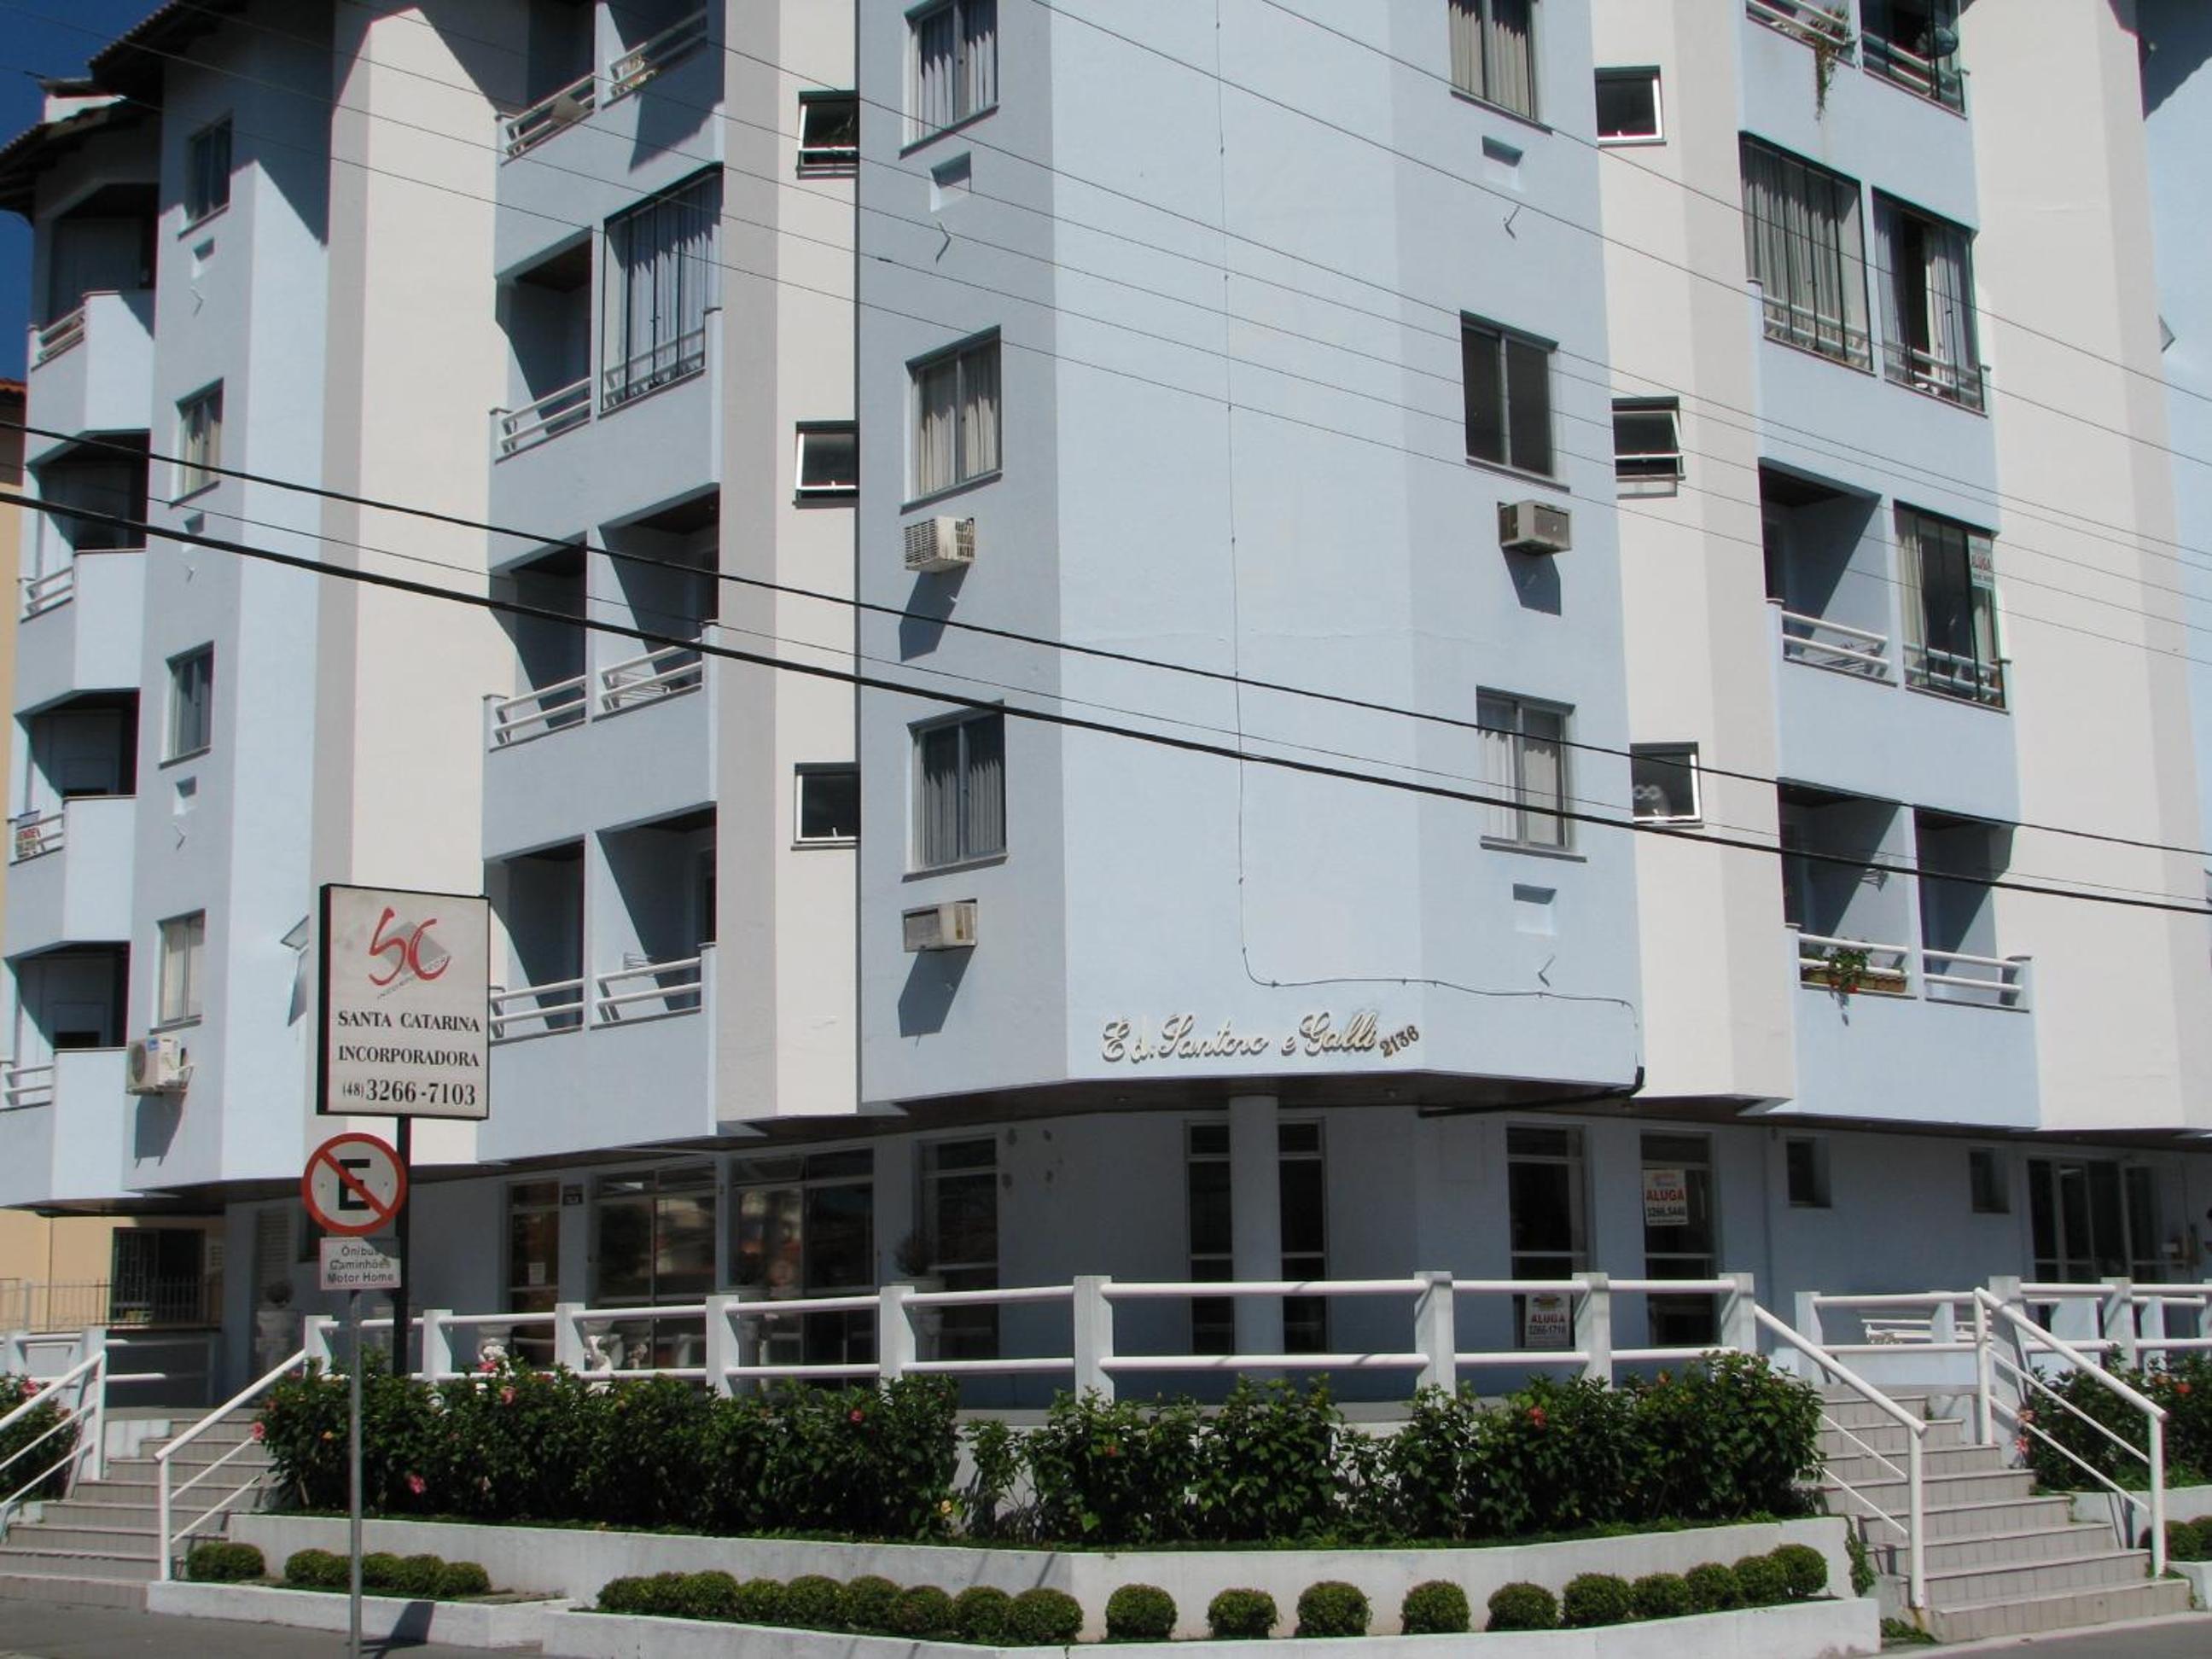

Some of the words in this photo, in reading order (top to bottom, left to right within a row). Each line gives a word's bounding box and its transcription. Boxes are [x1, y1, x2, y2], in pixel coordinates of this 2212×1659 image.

[338, 1010, 392, 1027] SANTA
[400, 1012, 480, 1033] CATARINA
[1160, 1014, 1271, 1059] Santoro
[1281, 1034, 1296, 1057] e
[1299, 1011, 1379, 1057] Galli
[338, 1045, 480, 1067] INCORPORADORA
[339, 1159, 370, 1210] E
[1646, 1189, 1685, 1202] ALUGA
[328, 1272, 359, 1284] Motor
[363, 1272, 393, 1282] Home
[1531, 1313, 1565, 1324] ALUGA
